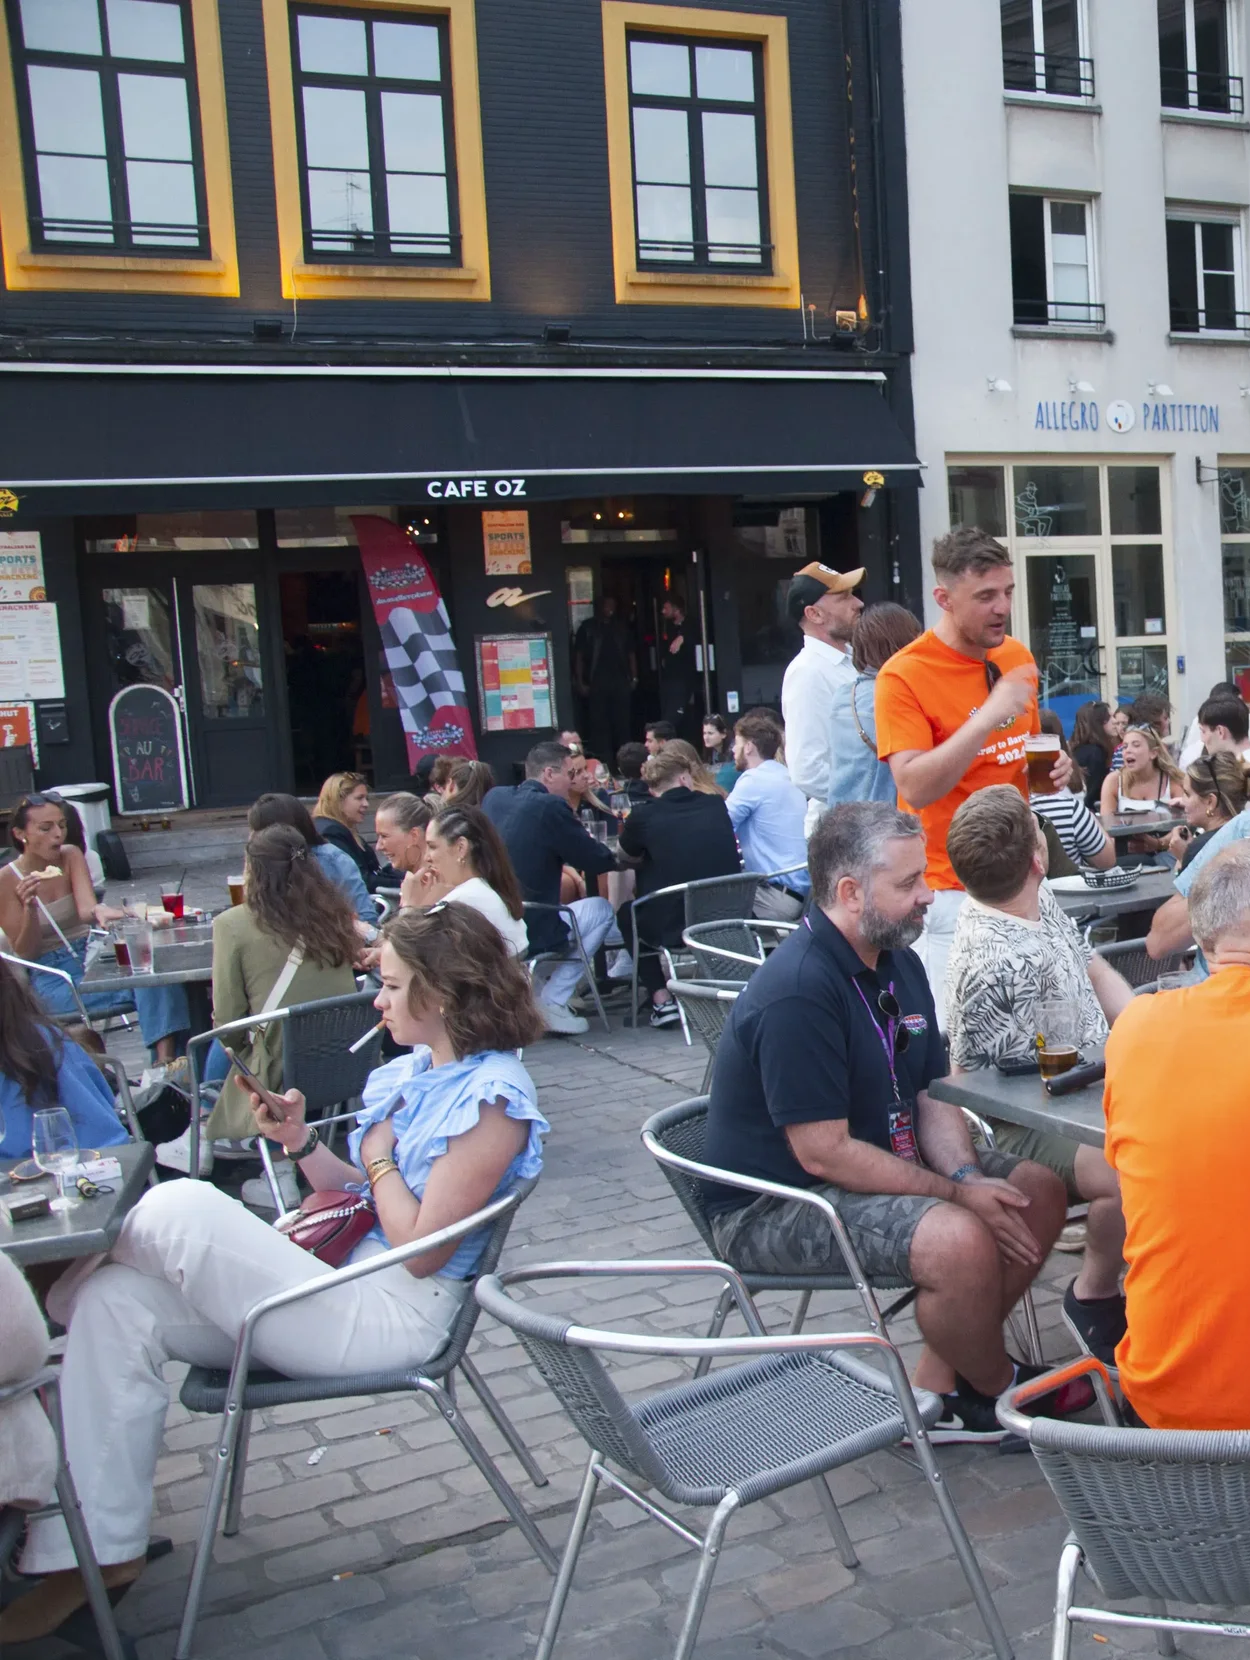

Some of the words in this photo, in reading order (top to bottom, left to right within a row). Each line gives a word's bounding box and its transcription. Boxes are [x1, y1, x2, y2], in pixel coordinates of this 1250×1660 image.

[1035, 401, 1099, 431] ALLEGRO
[1143, 402, 1220, 433] PARTITION
[427, 481, 488, 498] CAFE
[494, 479, 527, 496] OZ
[488, 532, 525, 541] SPORTS
[0, 555, 37, 564] PORTS
[136, 740, 152, 756] AU
[997, 741, 1006, 750] to
[128, 757, 164, 782] BAR
